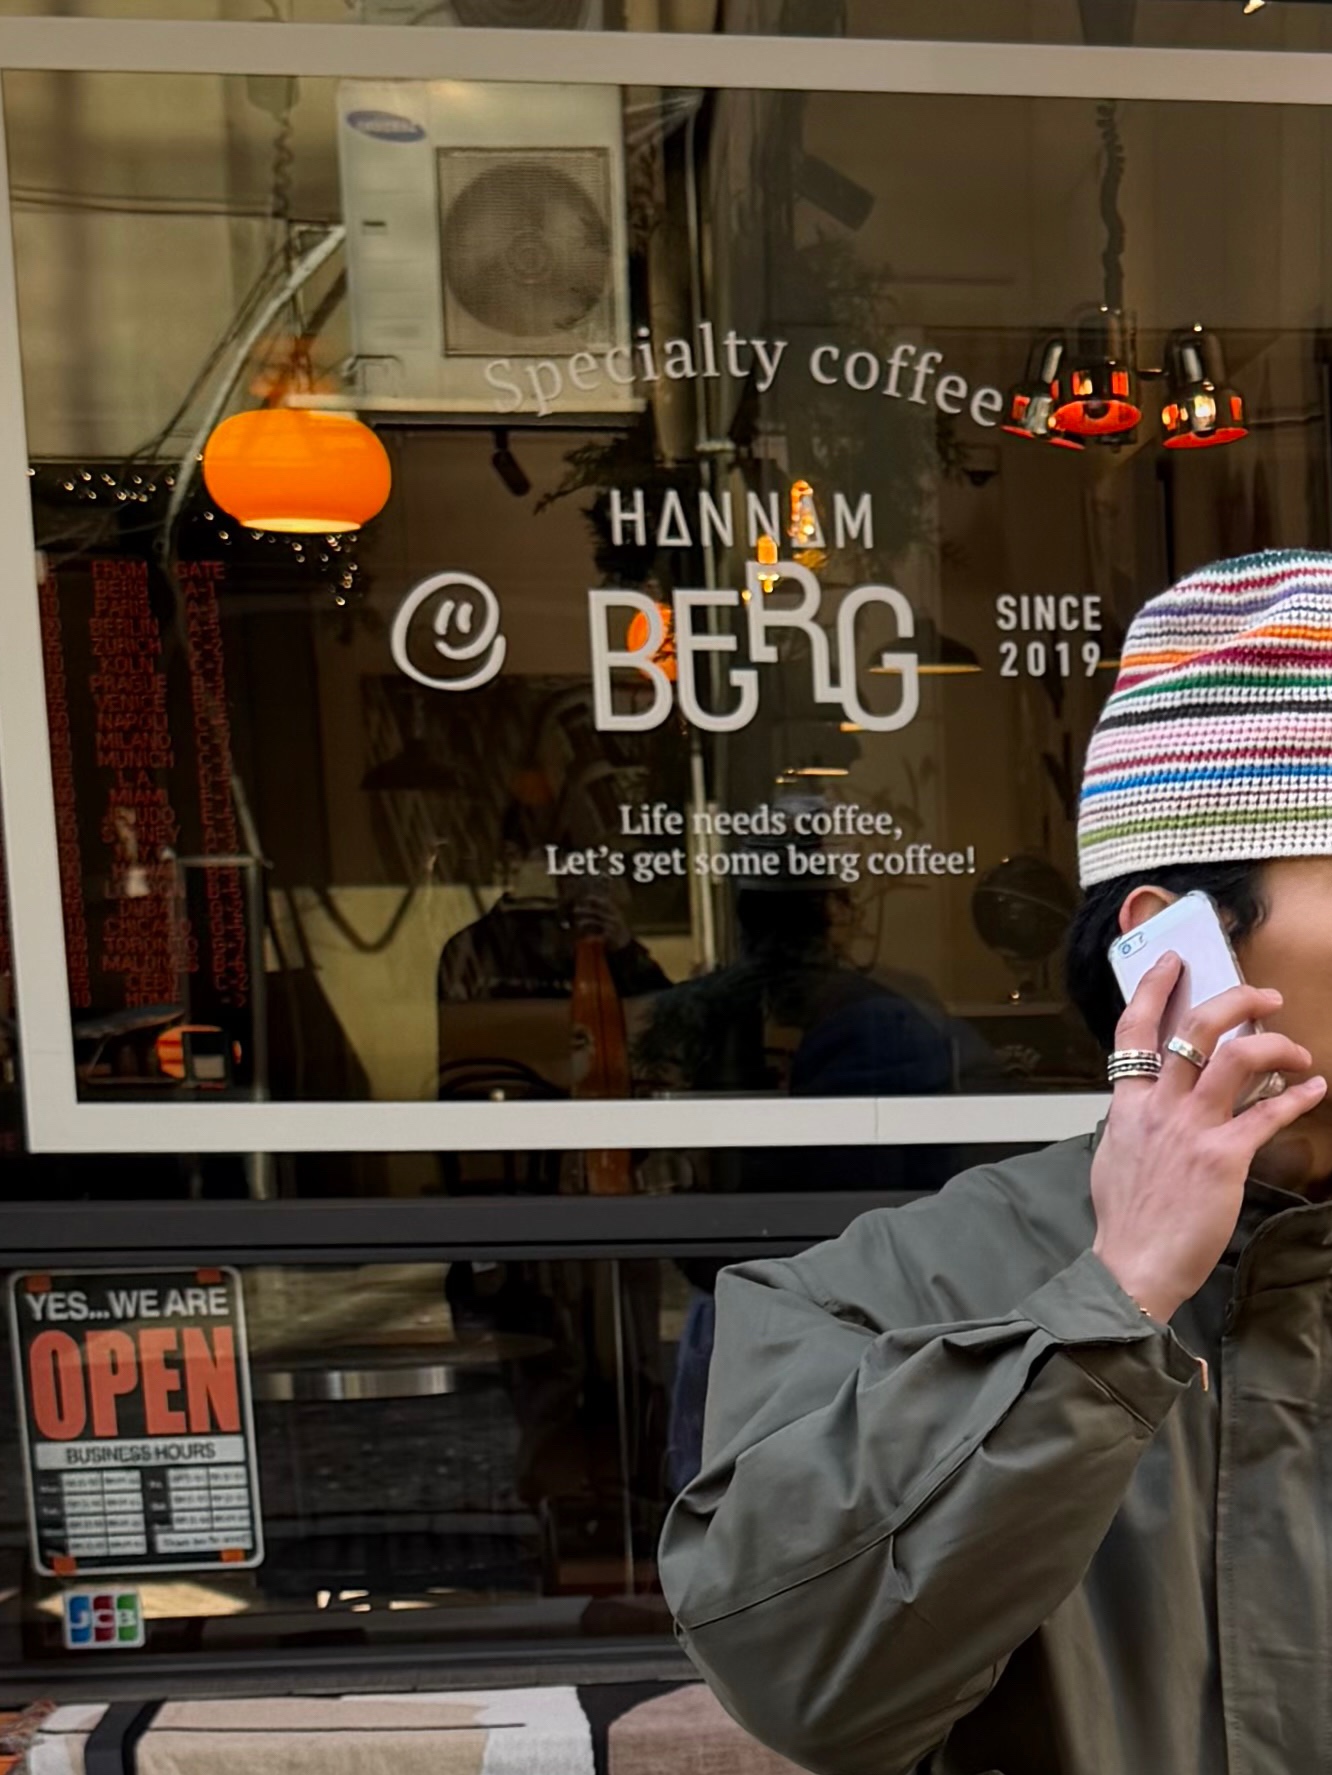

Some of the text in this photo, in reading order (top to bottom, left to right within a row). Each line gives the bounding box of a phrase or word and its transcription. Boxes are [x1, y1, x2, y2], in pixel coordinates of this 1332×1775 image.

[483, 322, 1003, 427] Specialty coffee
[91, 561, 225, 579] FROM GATE
[996, 596, 1102, 632] SINCE
[587, 560, 920, 732] BERG
[999, 641, 1100, 679] 2019
[89, 675, 167, 693] PRAGUE
[93, 694, 167, 712] VENICE
[96, 733, 172, 750] MILANO
[97, 751, 174, 769] MUNICH
[620, 804, 903, 841] Life needs coffee,
[545, 845, 975, 883] Let’s get some berg coffee!
[163, 1287, 229, 1317] ARE
[28, 1326, 242, 1441] OPEN
[66, 1442, 216, 1465] BUSINESS HOURS
